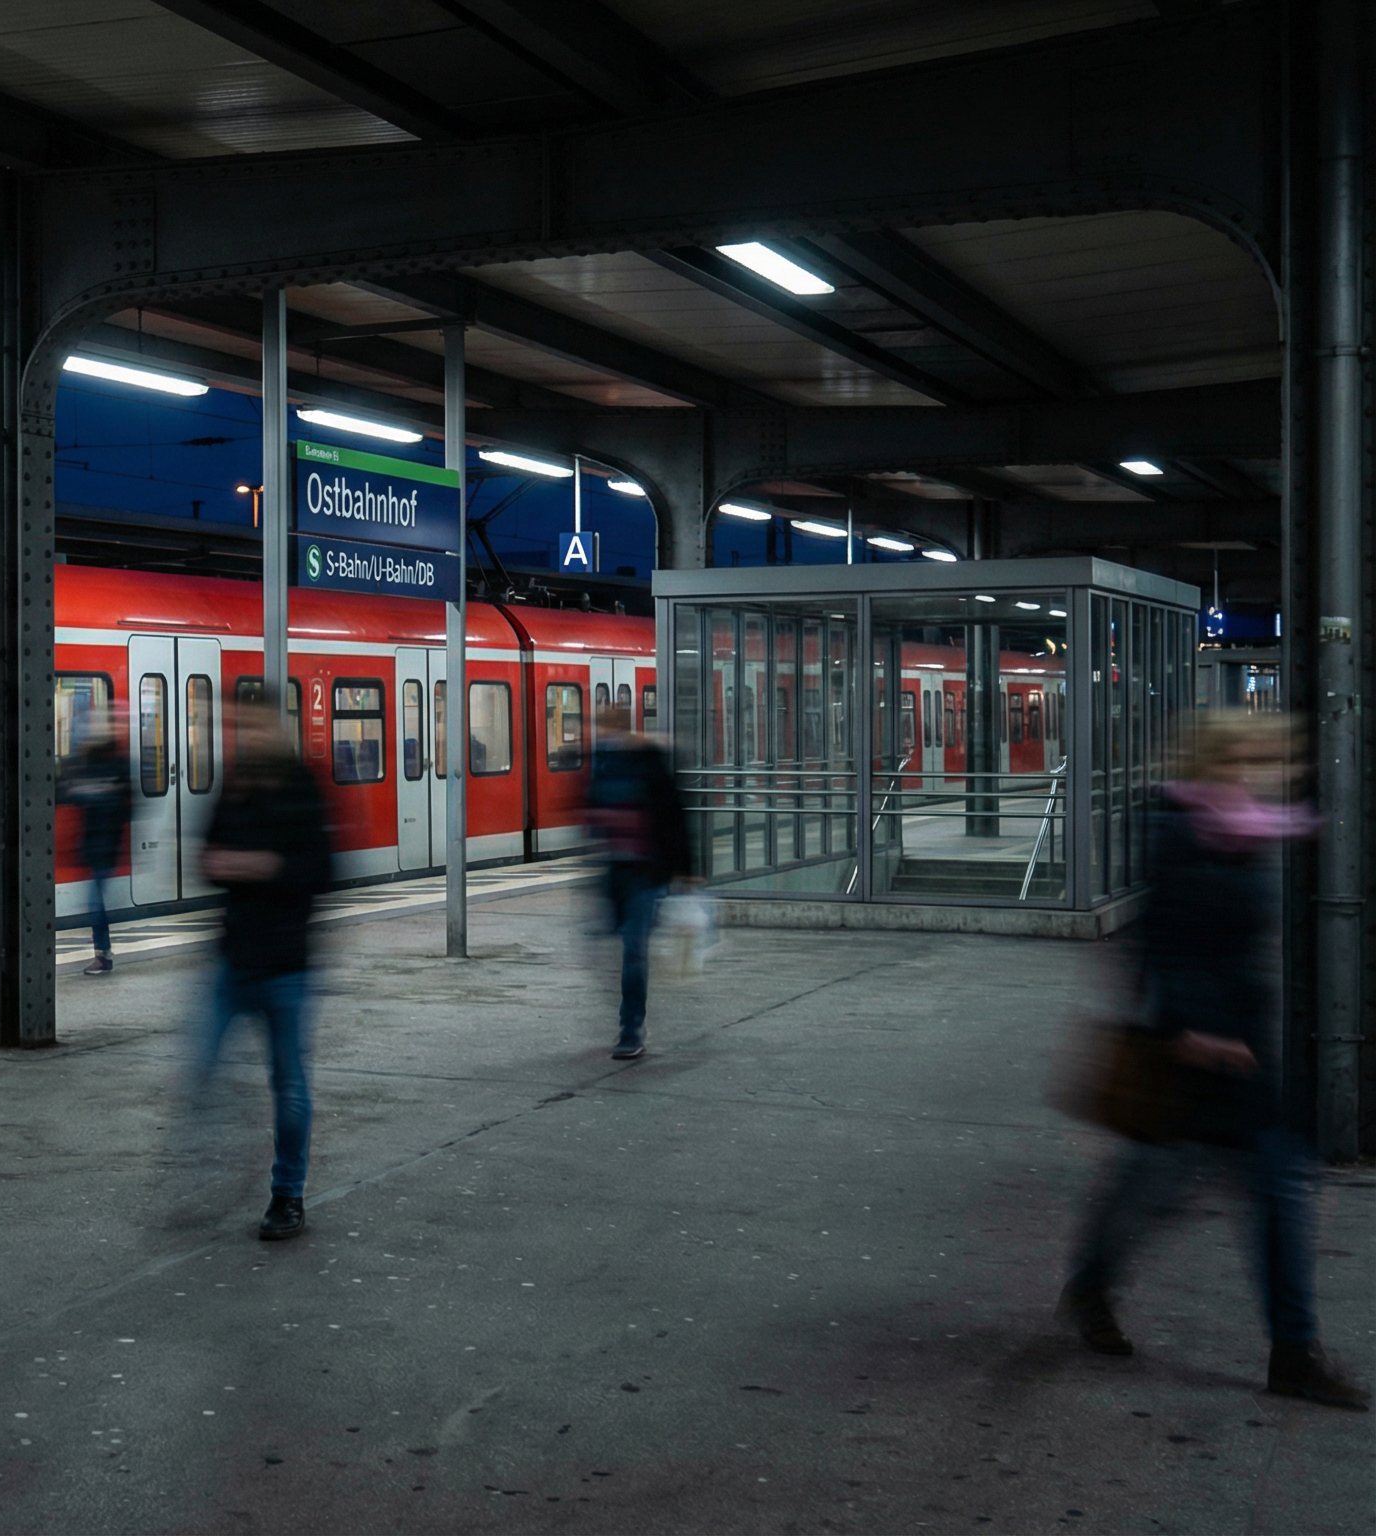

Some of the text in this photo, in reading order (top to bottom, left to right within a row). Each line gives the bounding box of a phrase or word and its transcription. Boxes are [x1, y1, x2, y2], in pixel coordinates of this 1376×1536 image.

[306, 472, 418, 528] Ostbahnhof
[308, 548, 435, 587] S S-Bahn/U-Bahn/DB
[563, 535, 588, 566] A
[313, 684, 323, 710] 2
